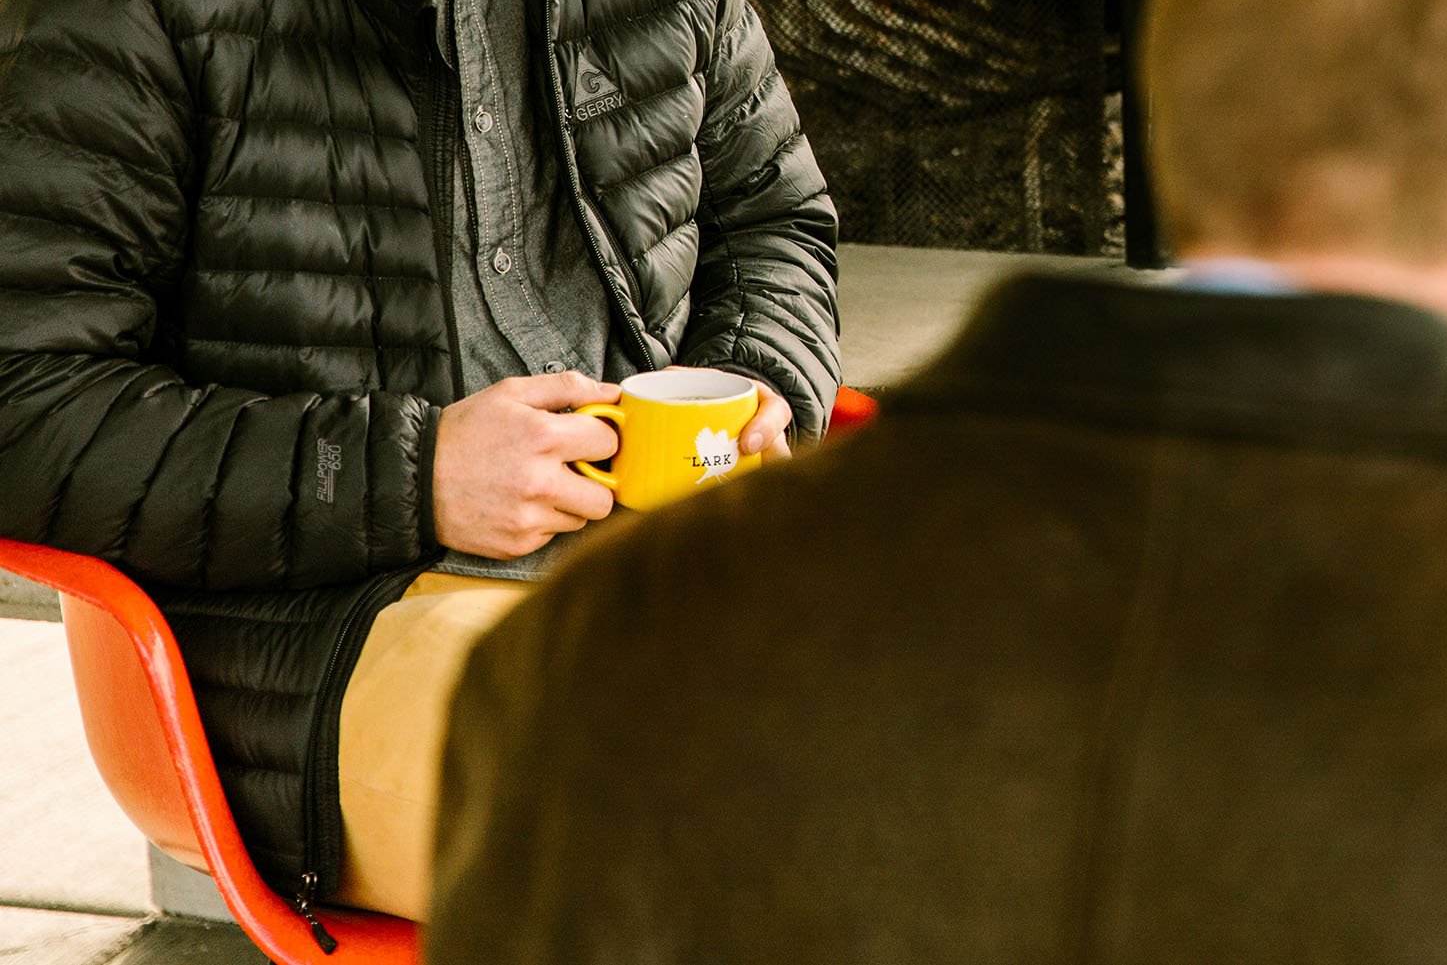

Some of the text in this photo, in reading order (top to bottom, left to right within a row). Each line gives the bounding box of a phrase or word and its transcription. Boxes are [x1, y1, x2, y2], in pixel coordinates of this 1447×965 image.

[580, 70, 602, 94] G
[576, 93, 623, 121] GERRY
[327, 445, 341, 470] 650
[692, 454, 731, 467] LARK
